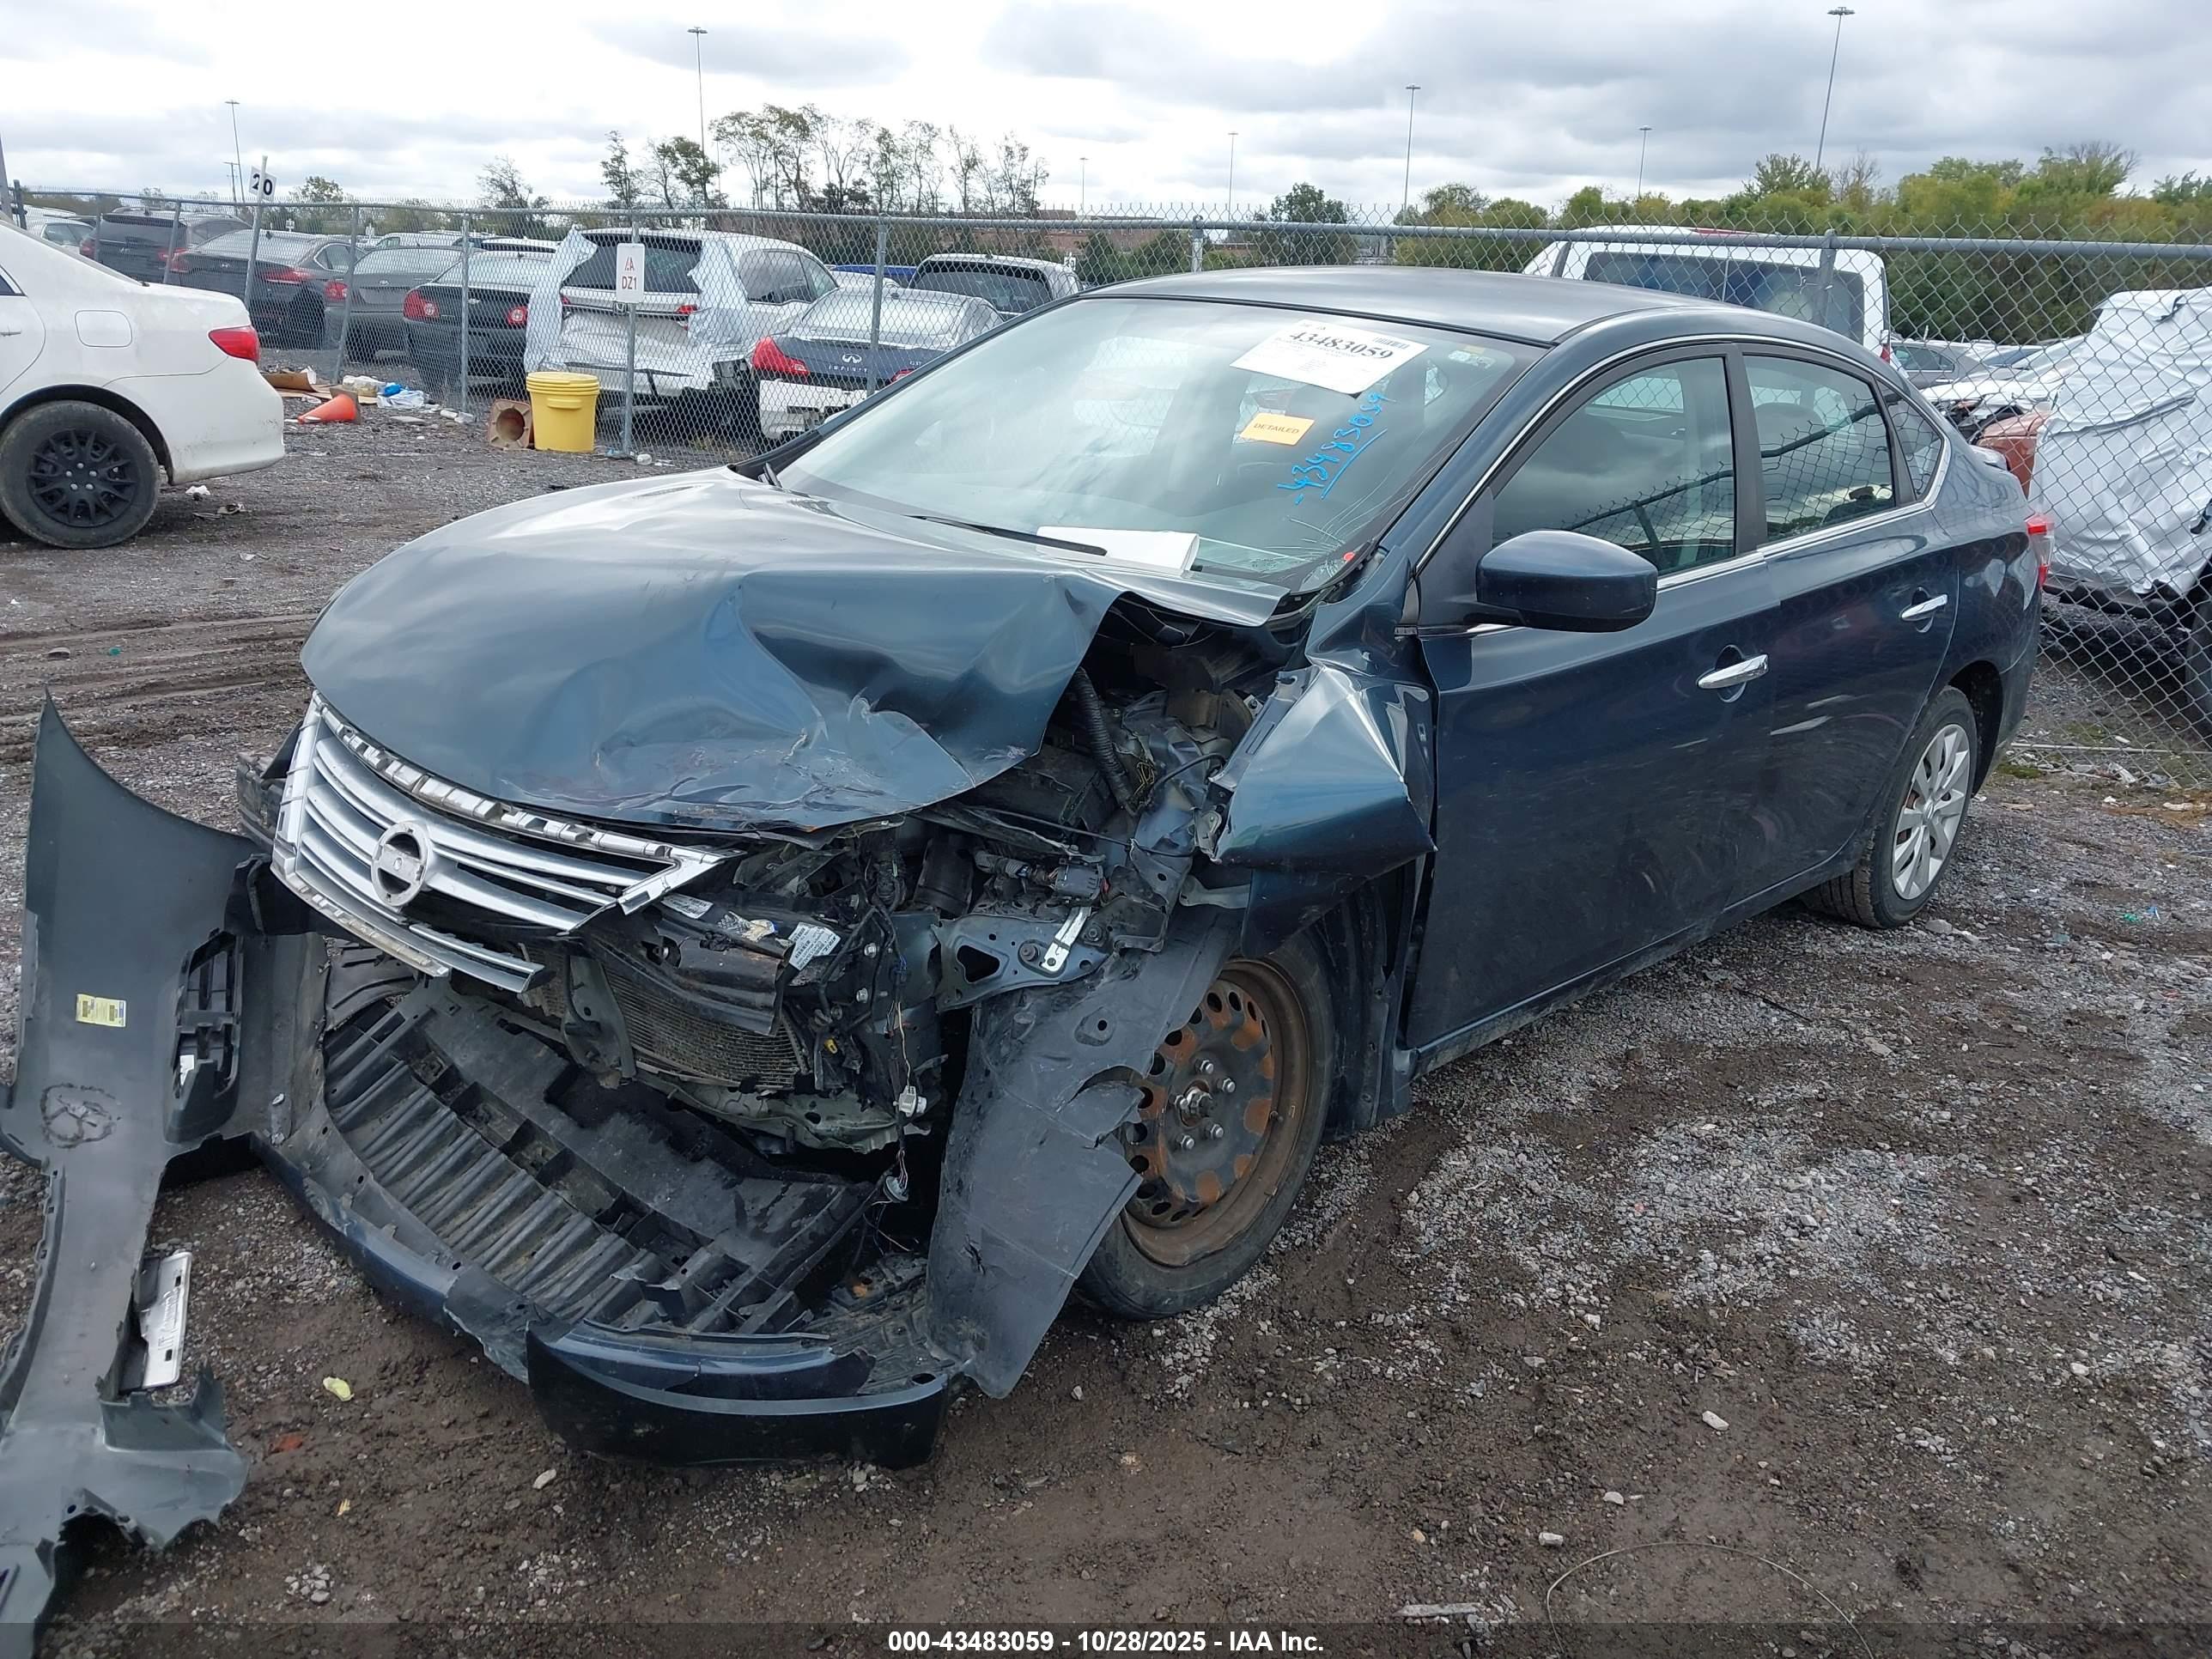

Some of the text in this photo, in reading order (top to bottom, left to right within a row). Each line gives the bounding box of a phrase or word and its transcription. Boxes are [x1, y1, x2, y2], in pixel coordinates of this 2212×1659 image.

[252, 173, 273, 196] 20
[621, 276, 637, 290] DZ1
[1289, 331, 1395, 360] 43483059
[828, 364, 869, 374] INFINIT
[1253, 422, 1300, 434] DETAILED
